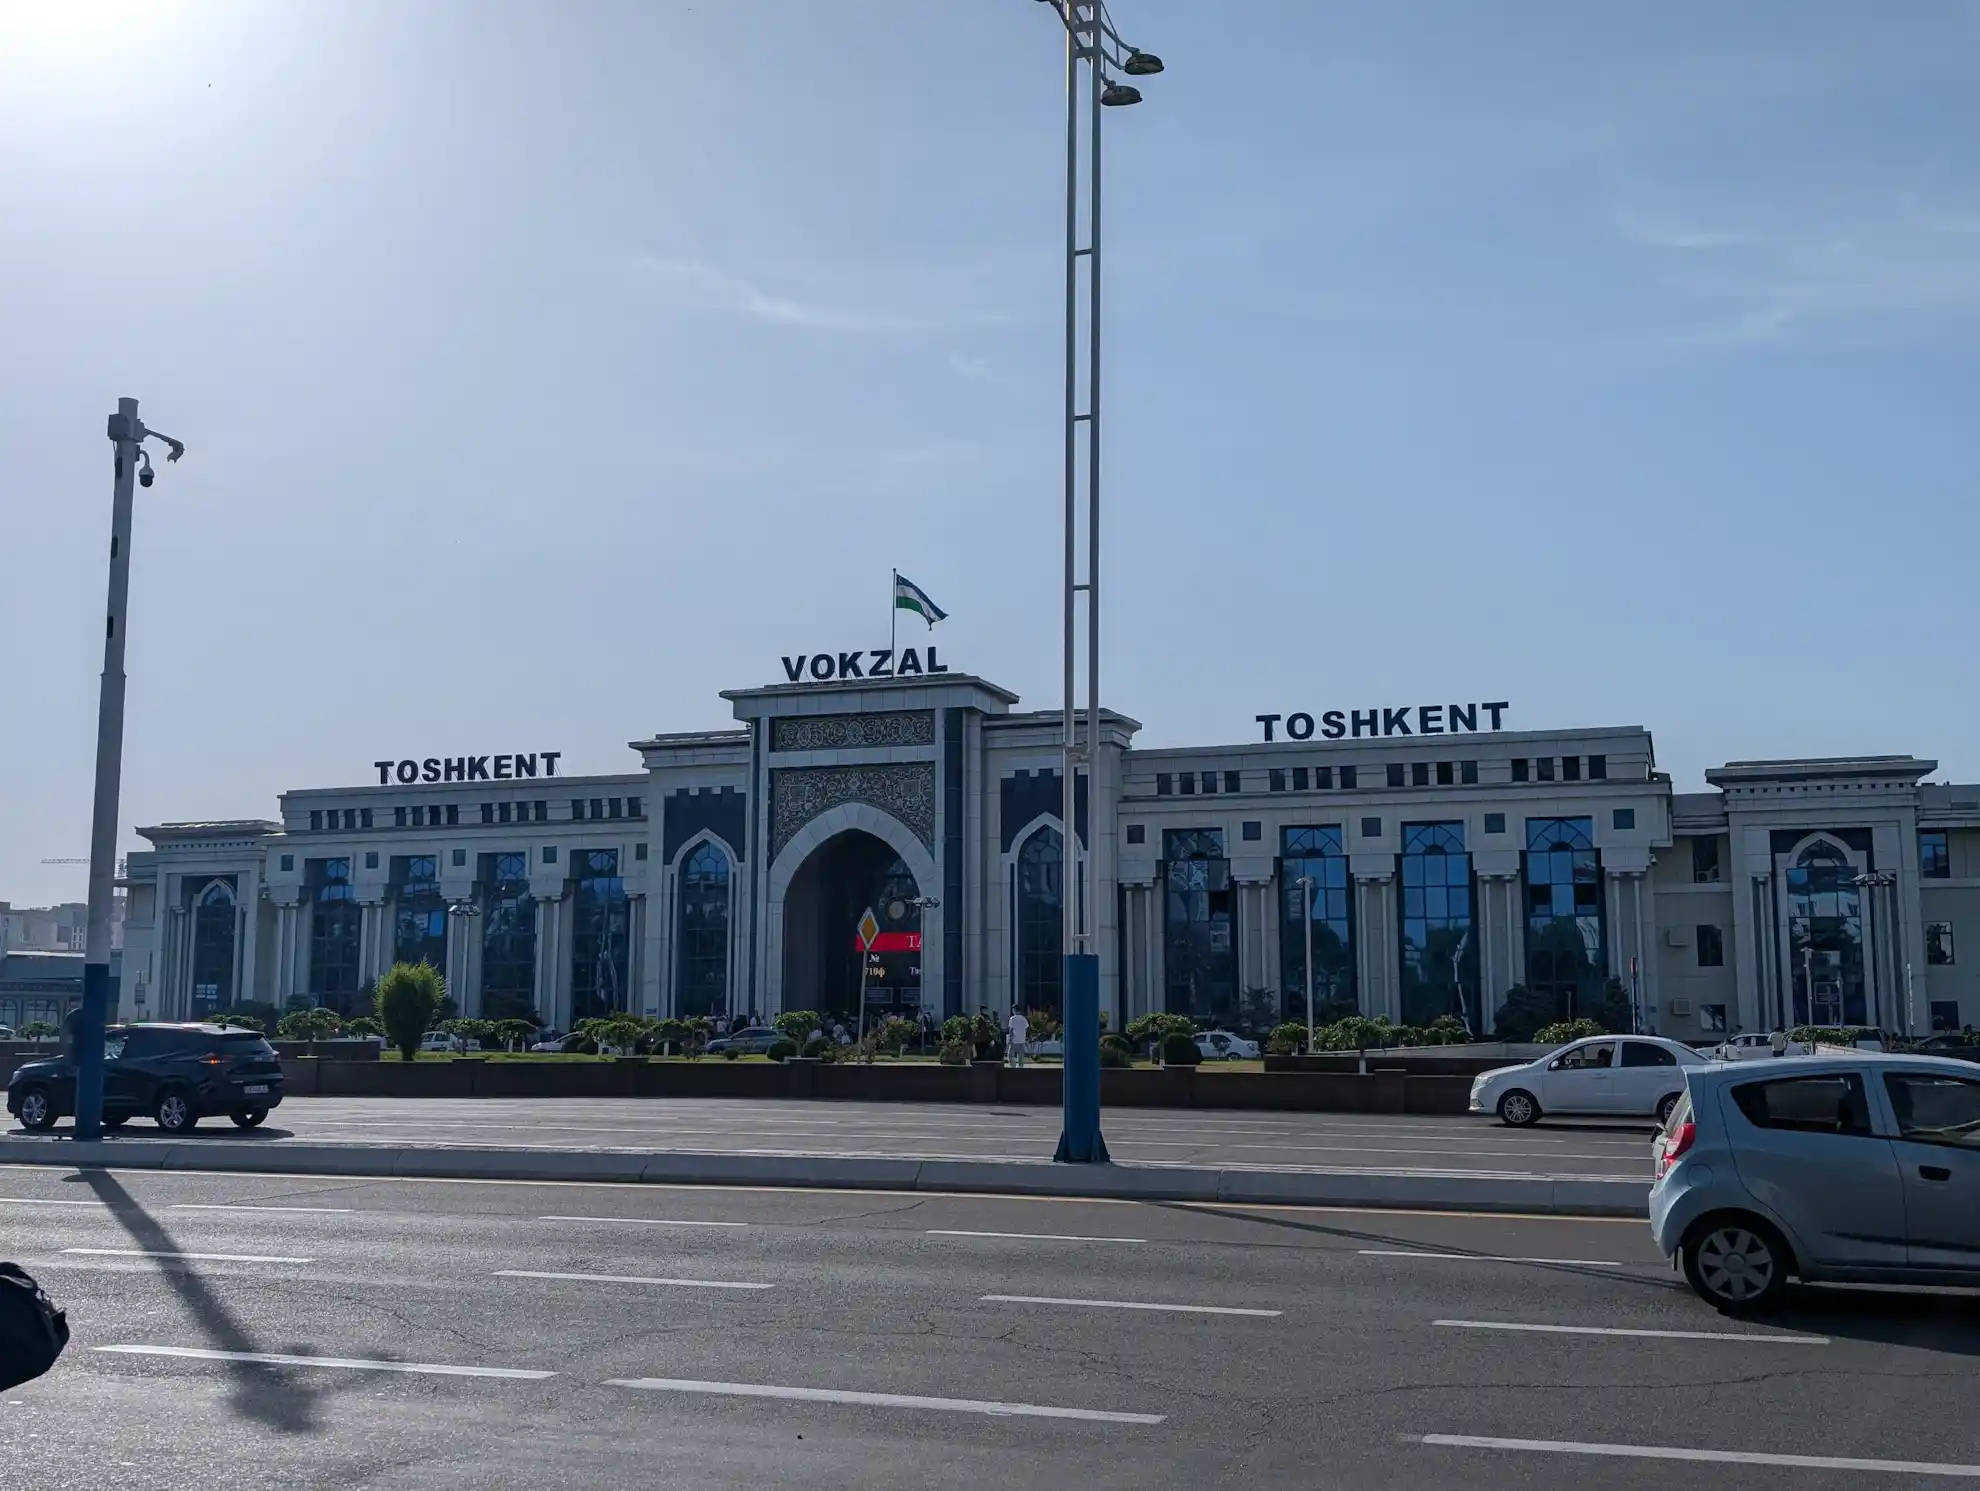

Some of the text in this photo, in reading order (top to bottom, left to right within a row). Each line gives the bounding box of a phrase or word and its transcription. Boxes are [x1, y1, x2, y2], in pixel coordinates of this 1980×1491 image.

[781, 647, 948, 682] VOKZAL
[1256, 702, 1509, 742] TOSHKENT
[374, 752, 561, 785] TOSHKENT
